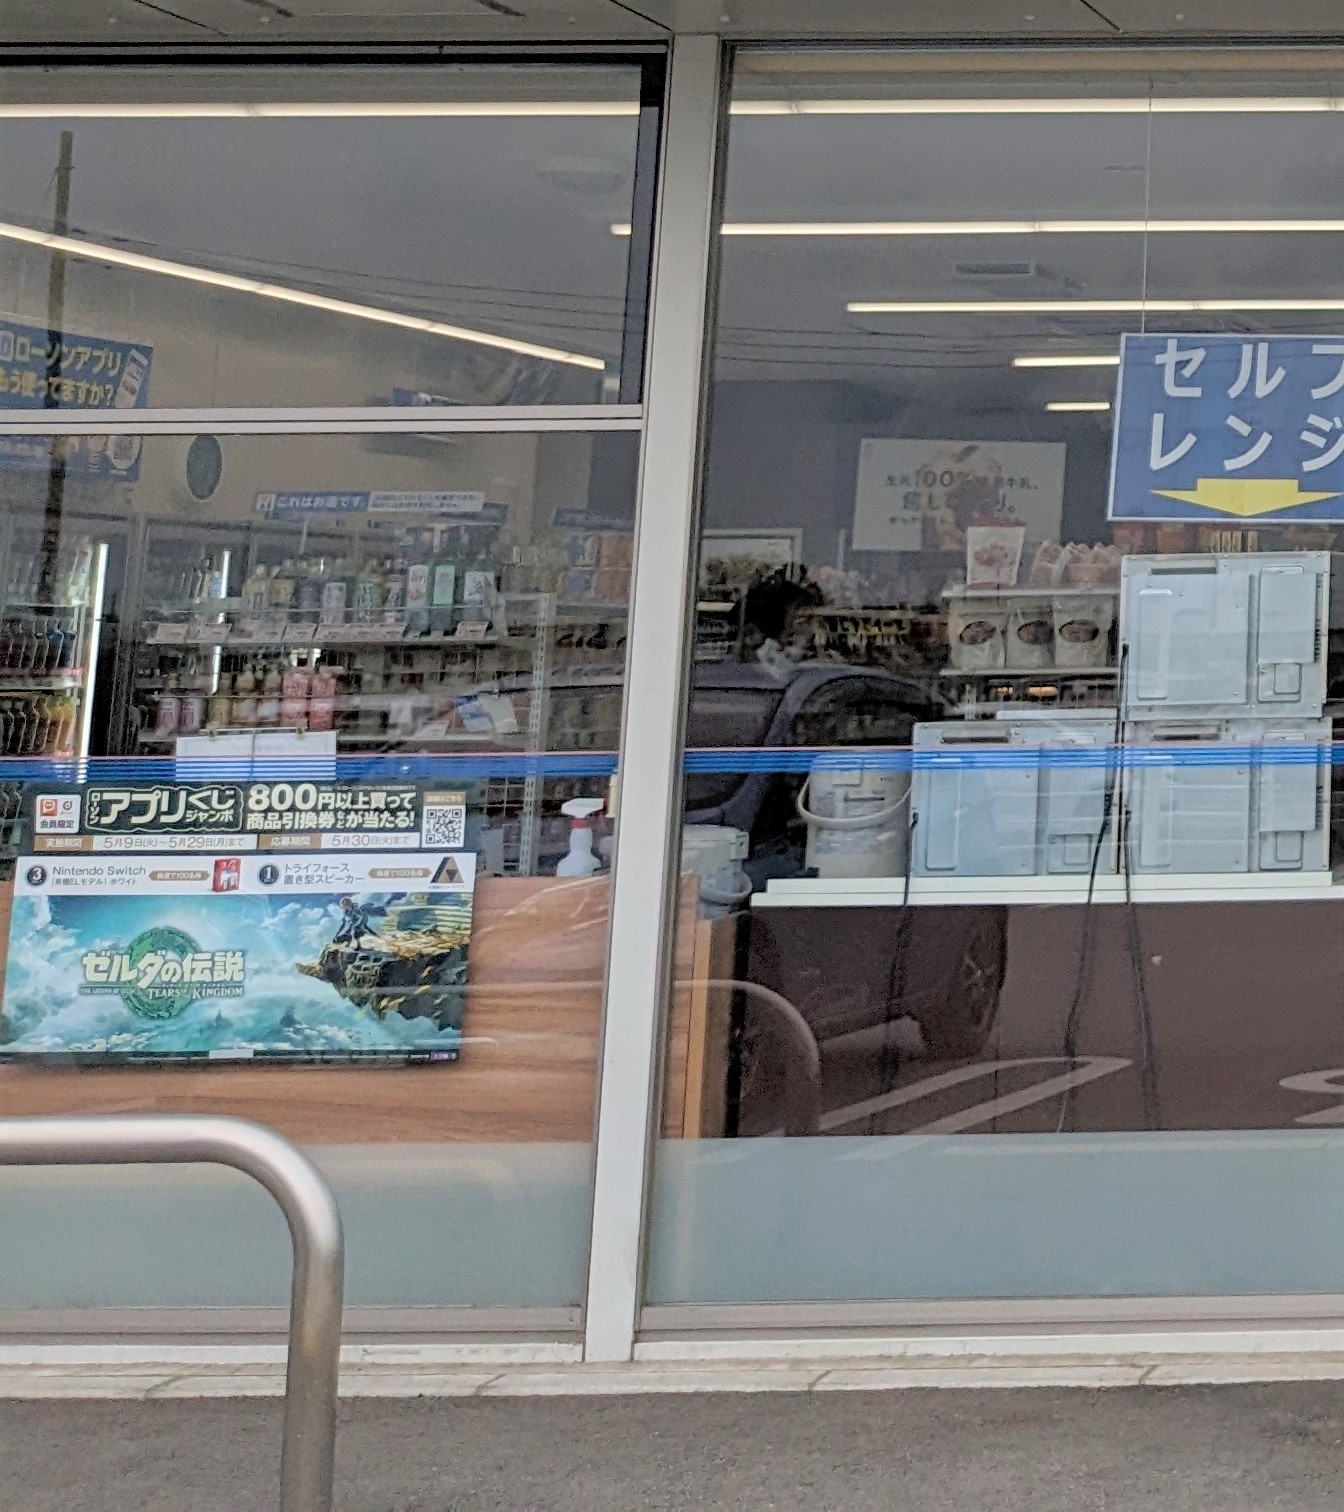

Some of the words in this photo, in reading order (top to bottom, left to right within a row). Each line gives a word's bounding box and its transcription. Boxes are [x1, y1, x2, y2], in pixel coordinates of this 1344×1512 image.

[100, 789, 236, 825] アプリくじ
[248, 783, 417, 811] 800円以上買って
[185, 809, 235, 823] ジャンボ
[52, 866, 104, 876] Nintendo
[107, 865, 146, 876] Switch
[82, 949, 245, 988] ゼルダの伝説
[193, 988, 243, 1000] KINGDOM
